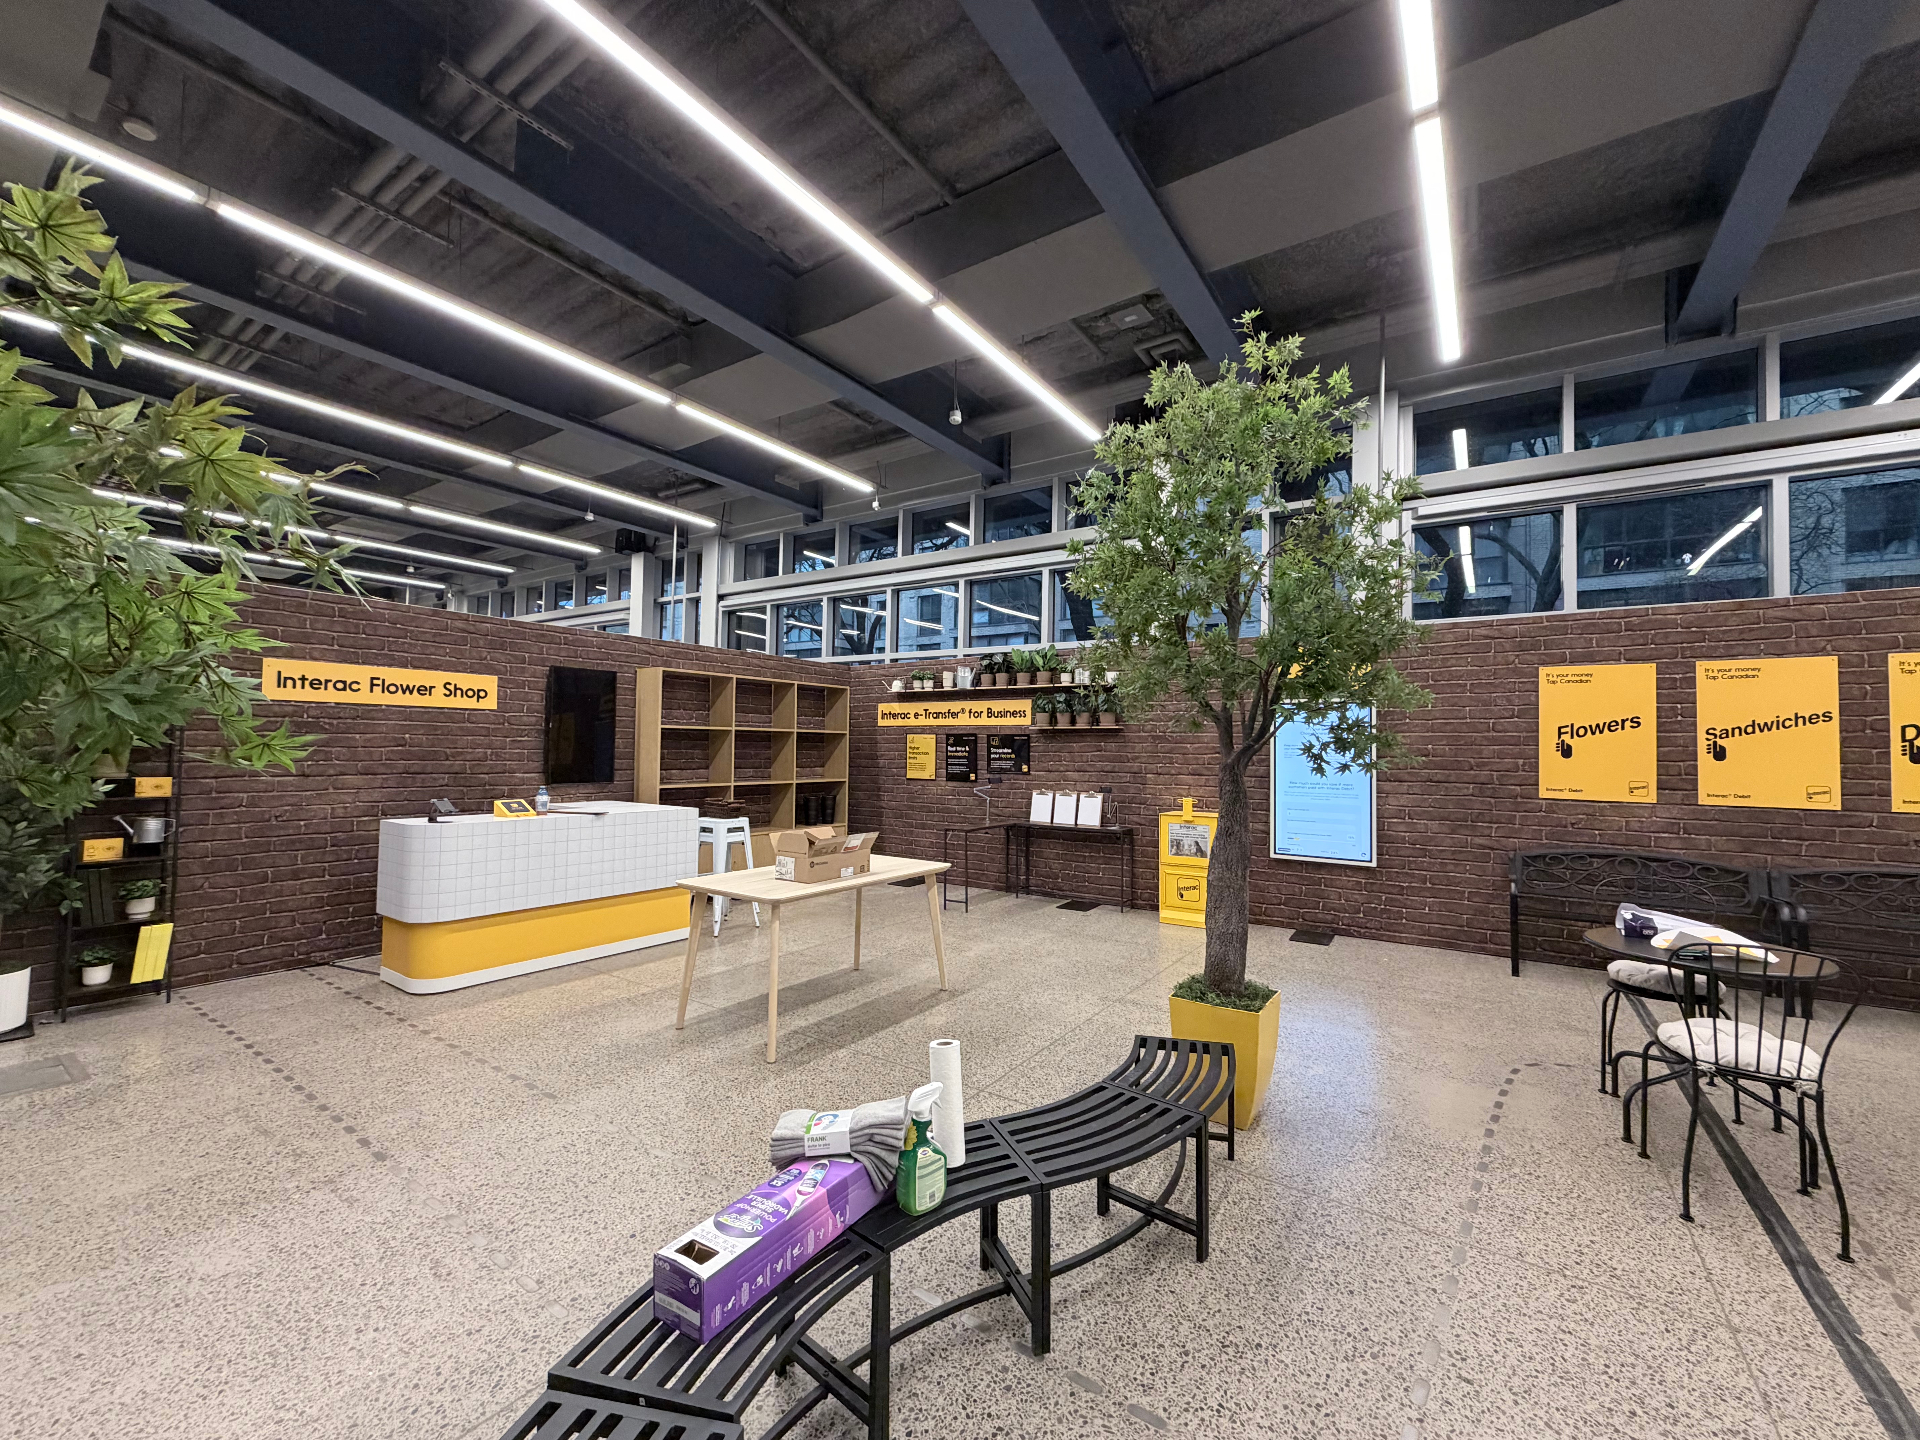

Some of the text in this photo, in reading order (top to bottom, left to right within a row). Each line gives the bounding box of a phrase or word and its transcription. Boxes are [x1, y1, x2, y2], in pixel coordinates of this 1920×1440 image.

[1716, 667, 1732, 675] your
[277, 670, 488, 703] Interac Flower Shop
[881, 707, 1027, 720] Interac e-Transfer® for Business
[1558, 715, 1641, 741] Flowers
[1705, 710, 1833, 741] Sandwiches
[1178, 884, 1199, 892] Interac
[806, 1135, 827, 1143] FRANK
[750, 1200, 775, 1213] SUPER
